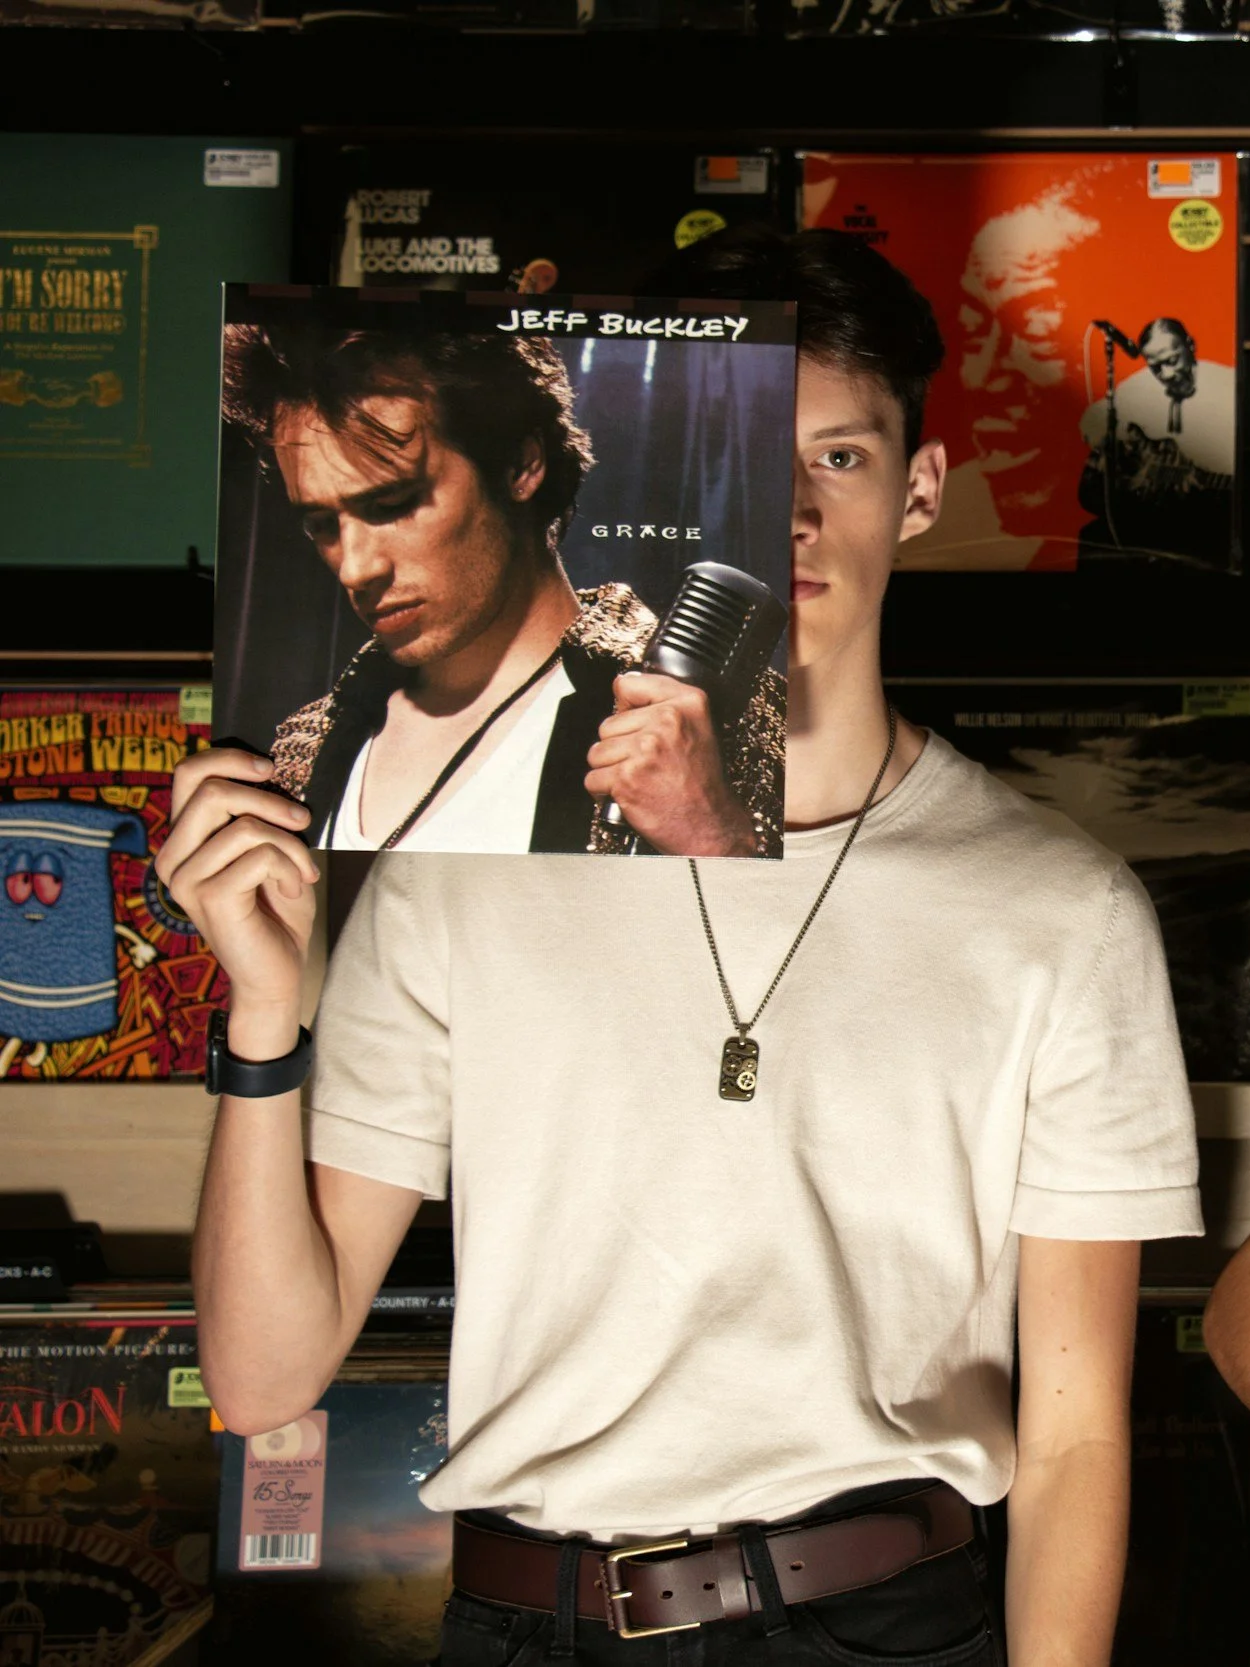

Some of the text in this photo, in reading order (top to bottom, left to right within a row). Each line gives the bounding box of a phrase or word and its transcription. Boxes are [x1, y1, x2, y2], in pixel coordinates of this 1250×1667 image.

[356, 187, 433, 208] ROBERT
[405, 235, 453, 256] AND
[455, 235, 495, 256] THE
[354, 254, 501, 275] LOCOMOTIVES
[41, 266, 128, 311] SORRY
[496, 309, 749, 341] JEFF BUCKLEY
[591, 524, 702, 540] GRACE
[0, 710, 188, 752] ARKER PRIMUS
[90, 735, 188, 774] WEEN
[0, 1266, 23, 1279] CKS
[372, 1296, 429, 1309] COUNTRY
[37, 1344, 108, 1358] MOTION
[0, 1384, 127, 1438] ALON
[253, 1481, 278, 1501] 15
